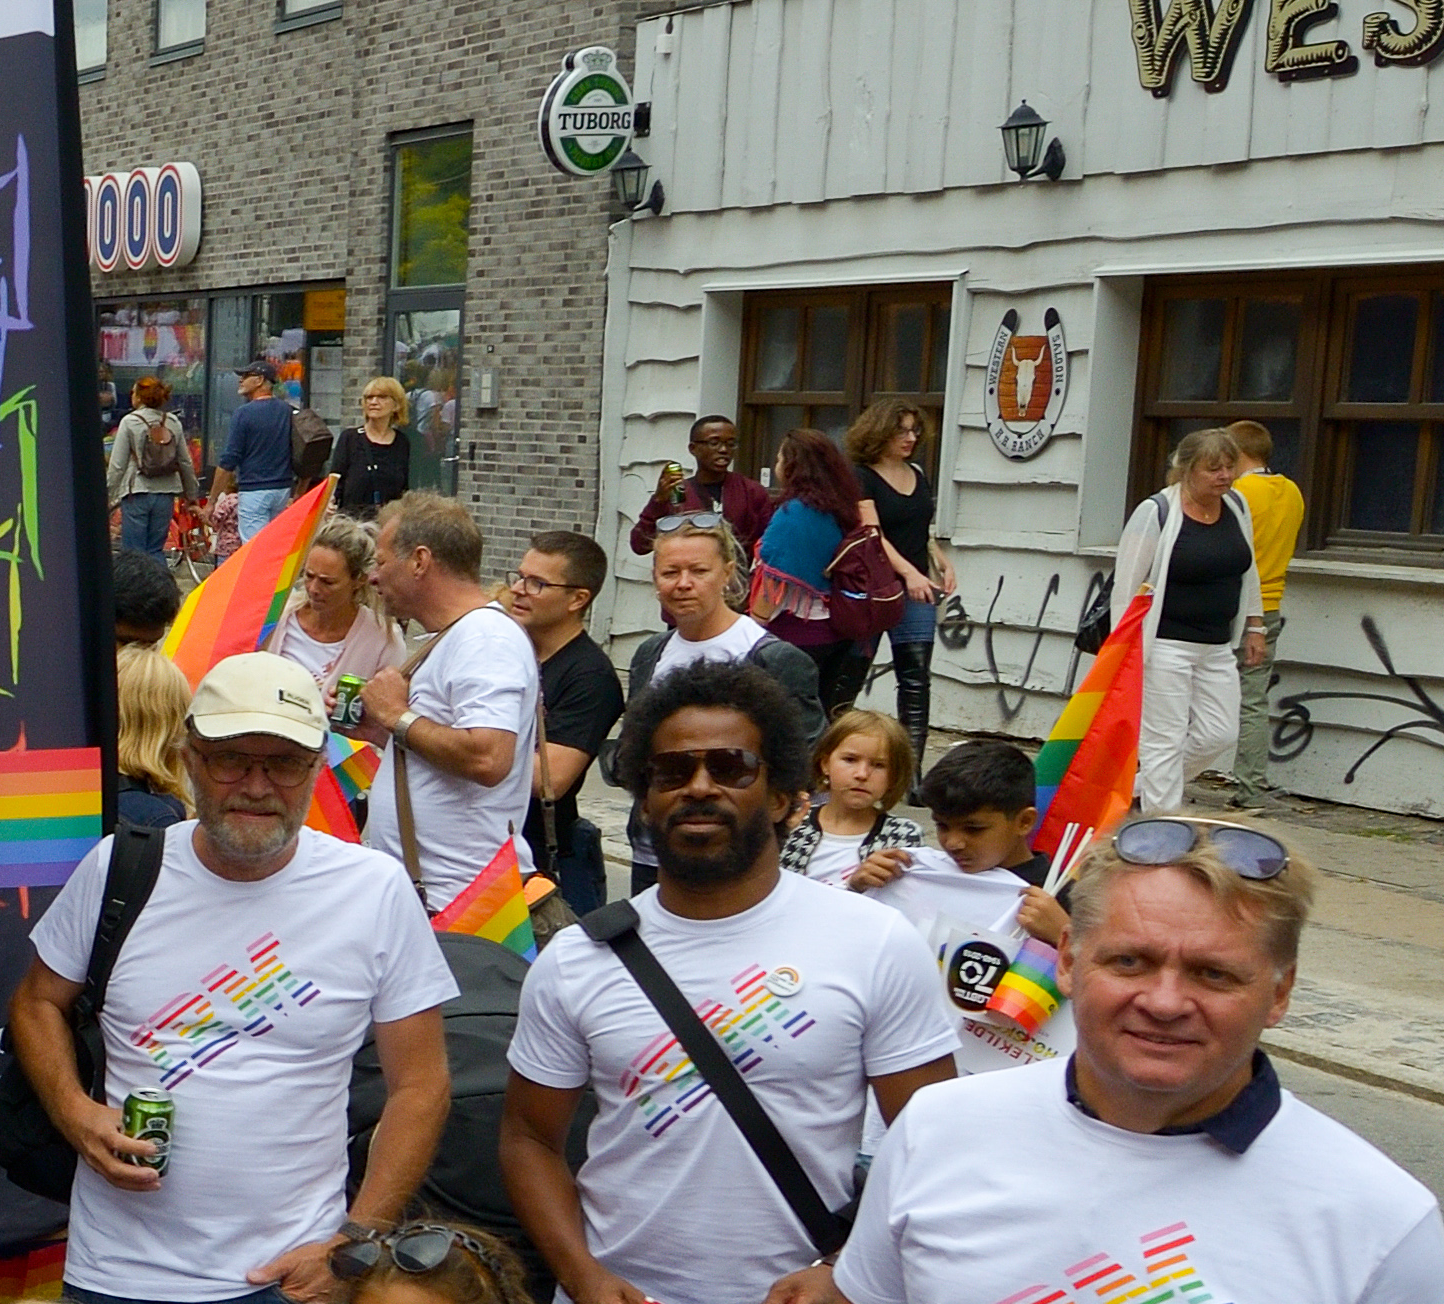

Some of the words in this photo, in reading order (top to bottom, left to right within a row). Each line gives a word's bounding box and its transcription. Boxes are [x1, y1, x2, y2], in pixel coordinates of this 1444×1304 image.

[558, 112, 632, 130] TUBORG
[988, 331, 1009, 386] WESTERN
[1051, 334, 1064, 384] SALOON
